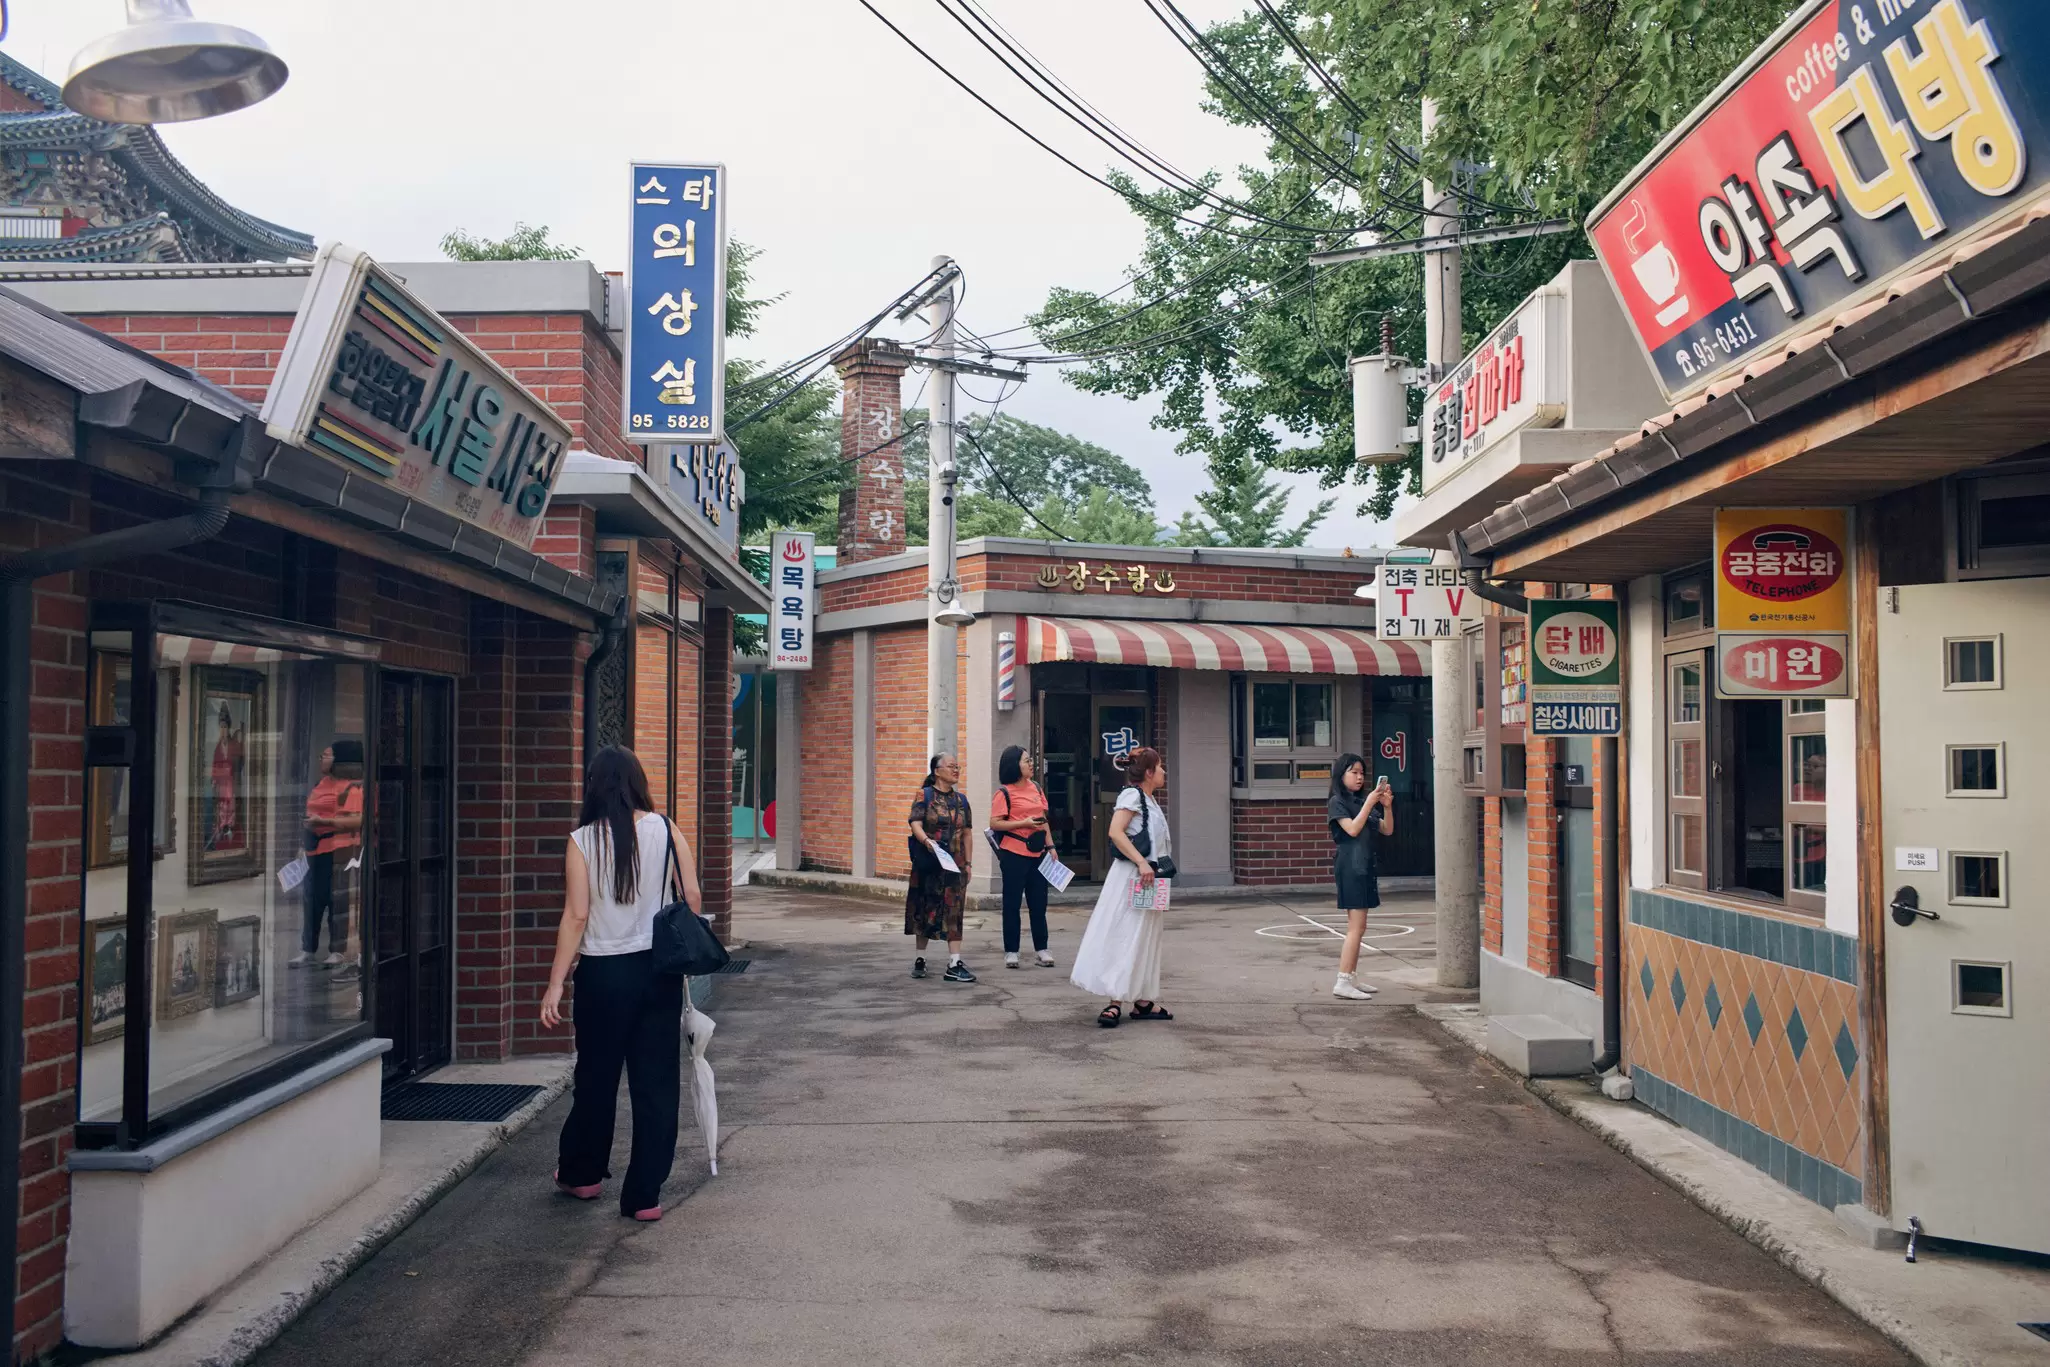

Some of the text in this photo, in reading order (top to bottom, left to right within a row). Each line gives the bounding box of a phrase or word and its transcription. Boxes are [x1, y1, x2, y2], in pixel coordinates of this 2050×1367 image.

[1786, 32, 1849, 102] coffee
[1851, 4, 1876, 45] &
[1699, 1, 2027, 319] 약속 다방
[866, 406, 898, 541] 장수탕
[1064, 561, 1150, 593] 장수탕
[1385, 568, 1418, 587] 전축
[1729, 551, 1837, 577] 공중전화
[1745, 579, 1820, 598] TELEPHONE
[781, 566, 805, 651] 목욕탕
[1386, 618, 1474, 637] 전기재
[1545, 626, 1607, 656] 담배
[1549, 657, 1602, 673] CIGARETTES
[1743, 646, 1823, 684] 미원
[1535, 705, 1618, 731] 칠성사이다
[1380, 731, 1406, 772] 여
